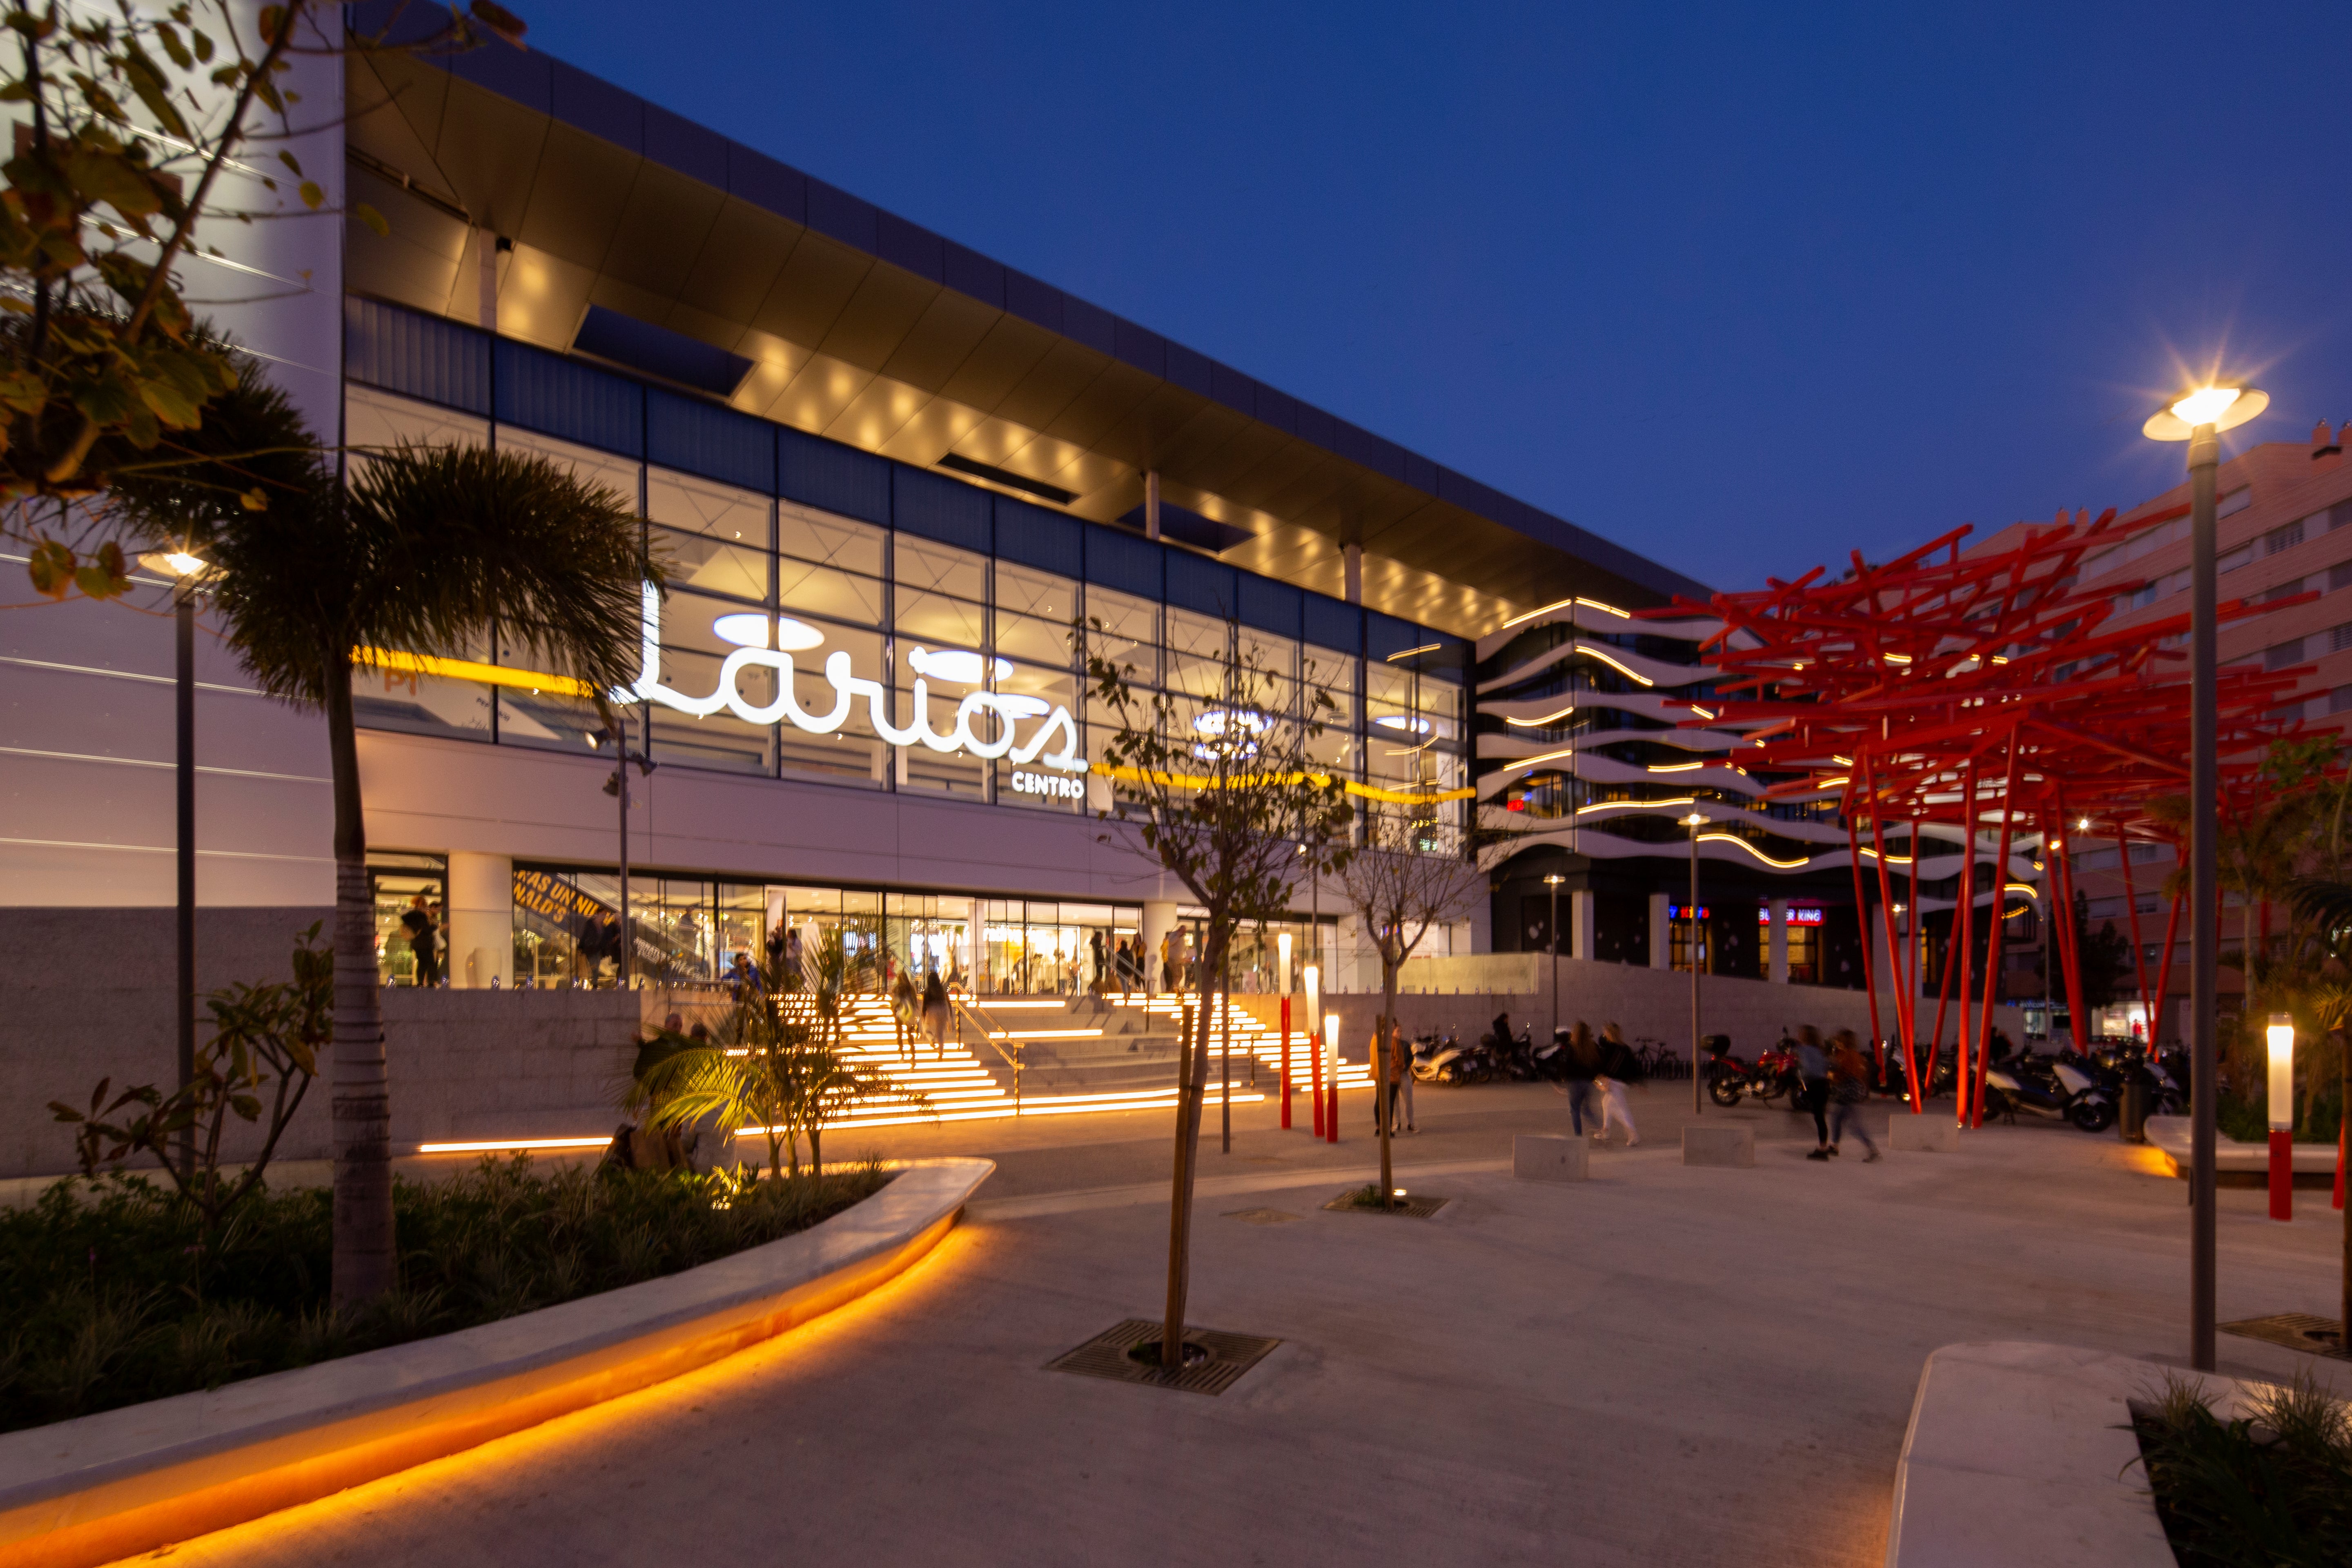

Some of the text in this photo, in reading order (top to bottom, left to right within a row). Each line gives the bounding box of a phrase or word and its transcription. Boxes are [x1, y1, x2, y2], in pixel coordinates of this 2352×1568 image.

[385, 668, 416, 697] P1
[609, 577, 1089, 773] Larios
[1012, 771, 1084, 799] CENTRO
[513, 882, 567, 923] NALD'S
[550, 882, 576, 906] UN
[573, 895, 615, 927] NUV
[1759, 908, 1822, 922] BUER KING
